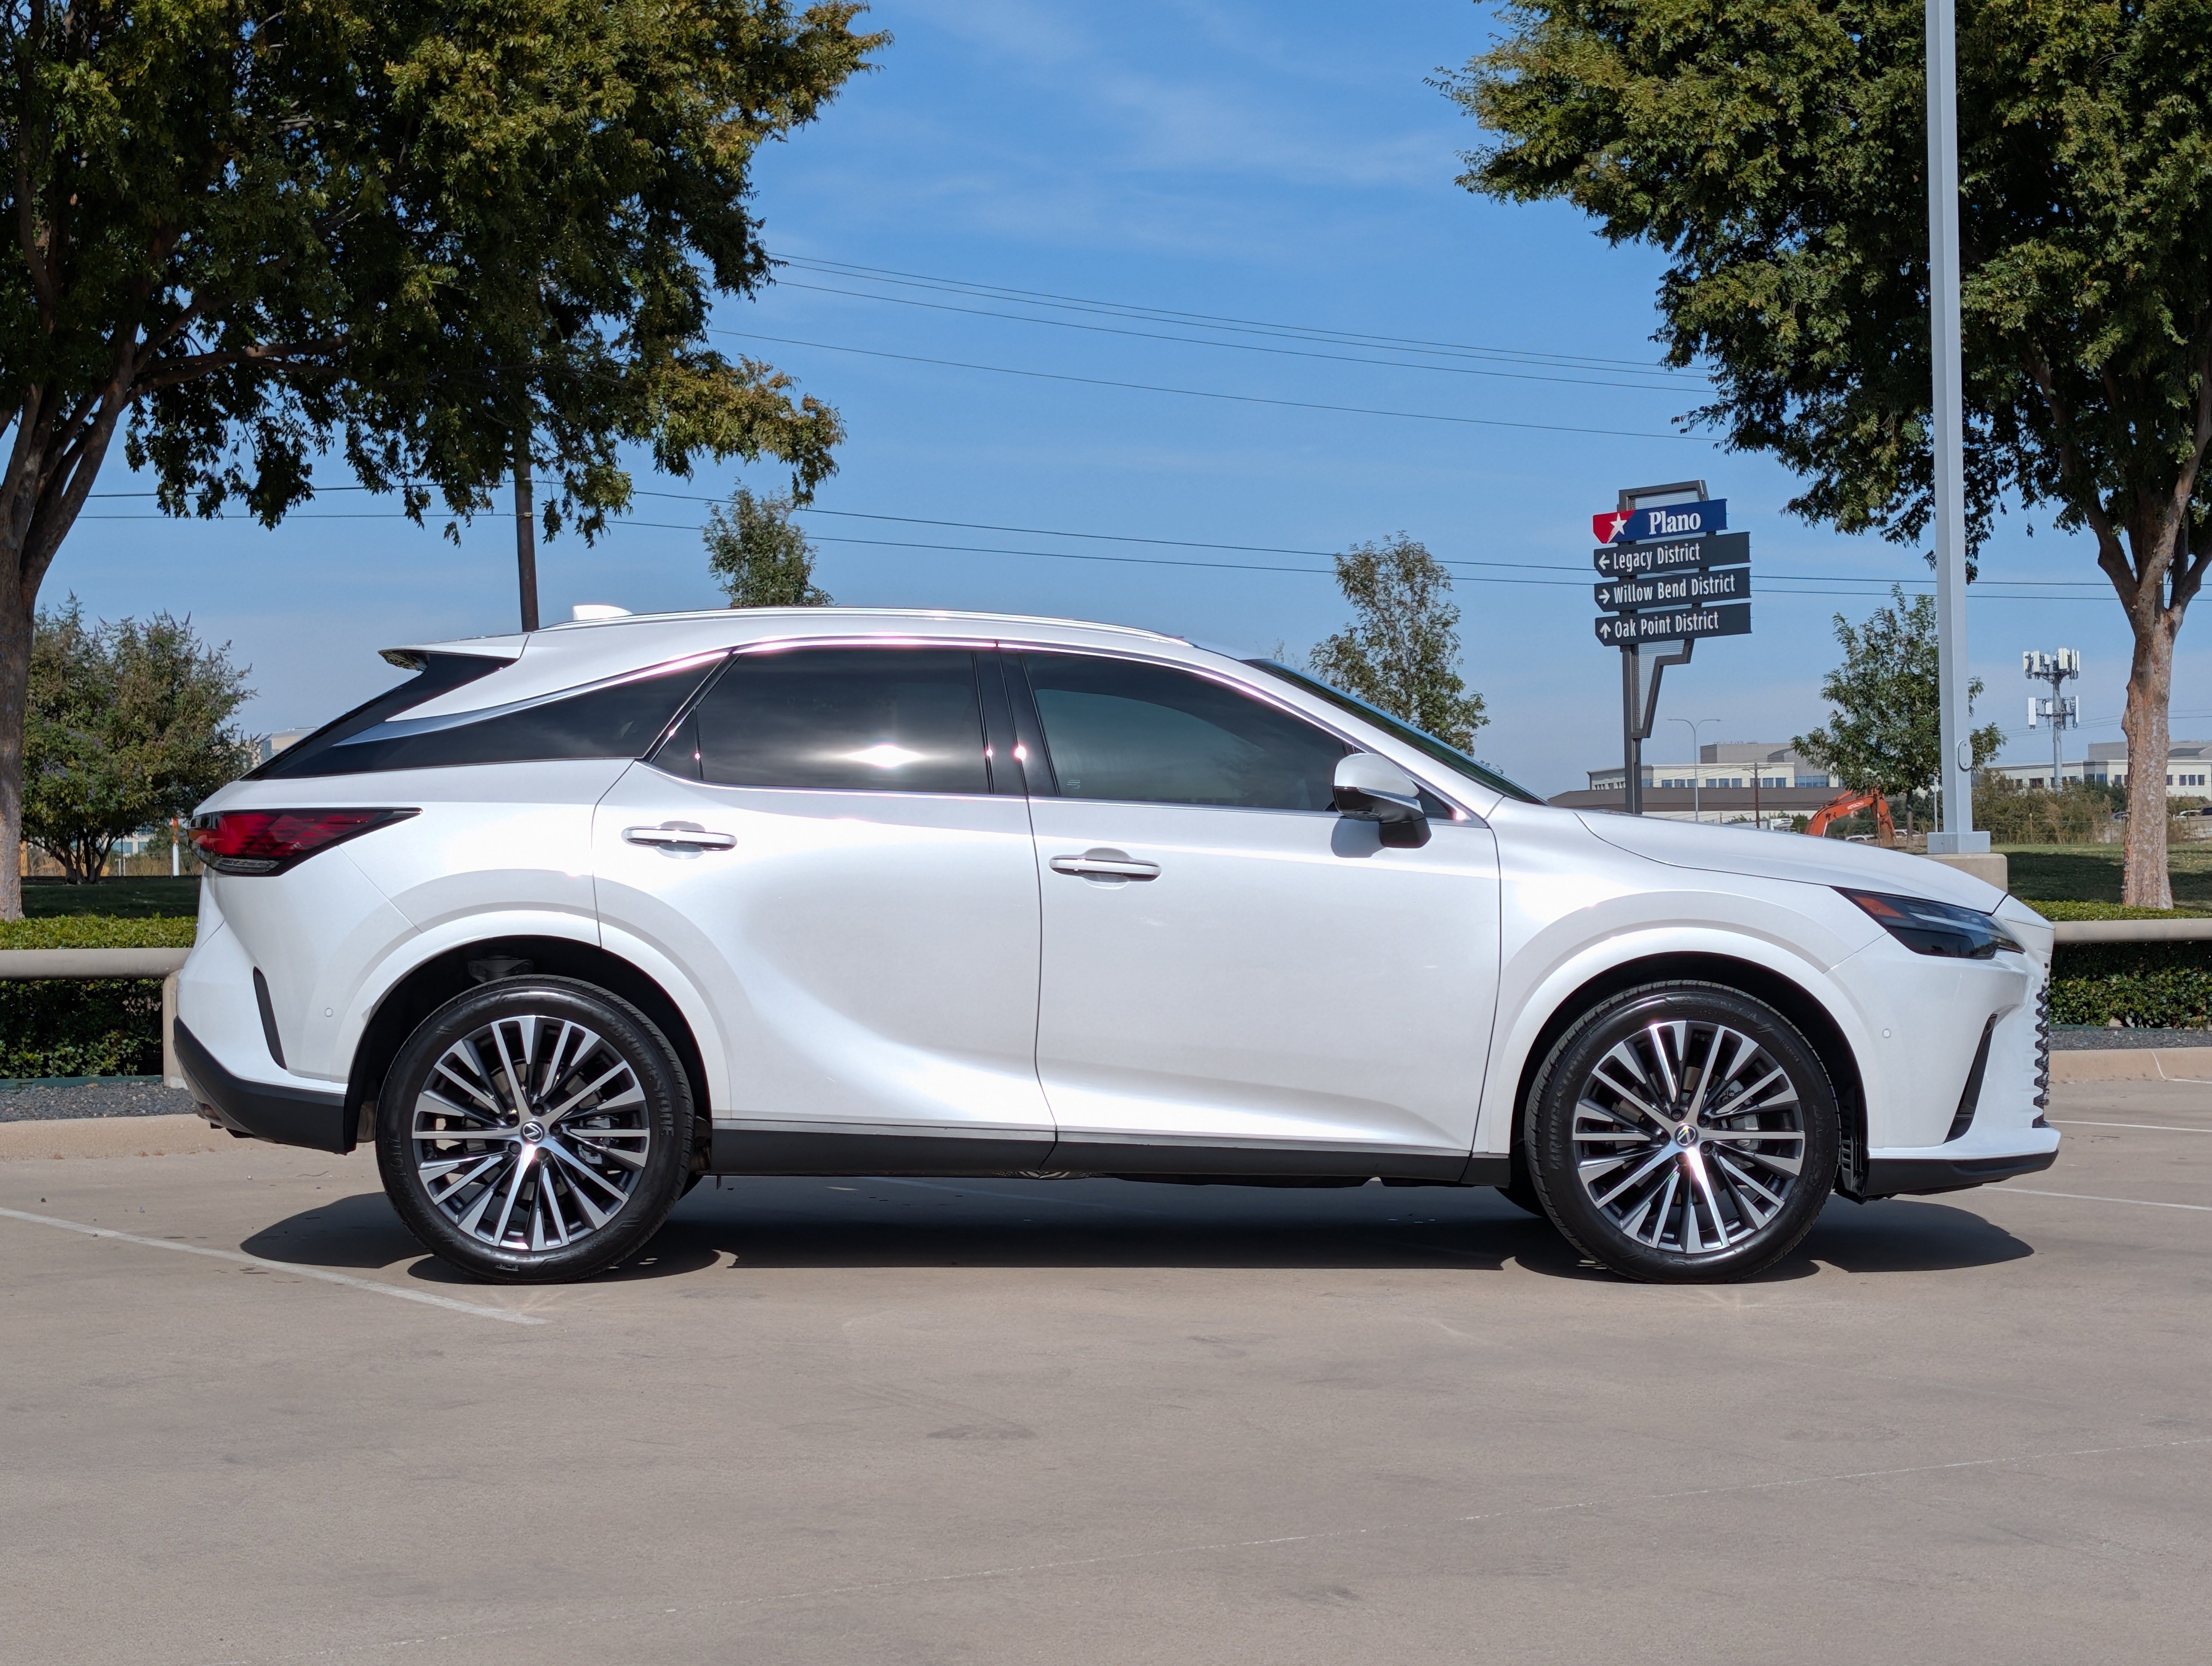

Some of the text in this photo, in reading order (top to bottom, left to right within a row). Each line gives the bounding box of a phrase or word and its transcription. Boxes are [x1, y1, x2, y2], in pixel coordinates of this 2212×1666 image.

[1649, 511, 1701, 535] Plano
[1614, 542, 1700, 572] Legacy District
[1614, 574, 1735, 604] Willow Bend District
[1615, 611, 1718, 638] Oak Point District
